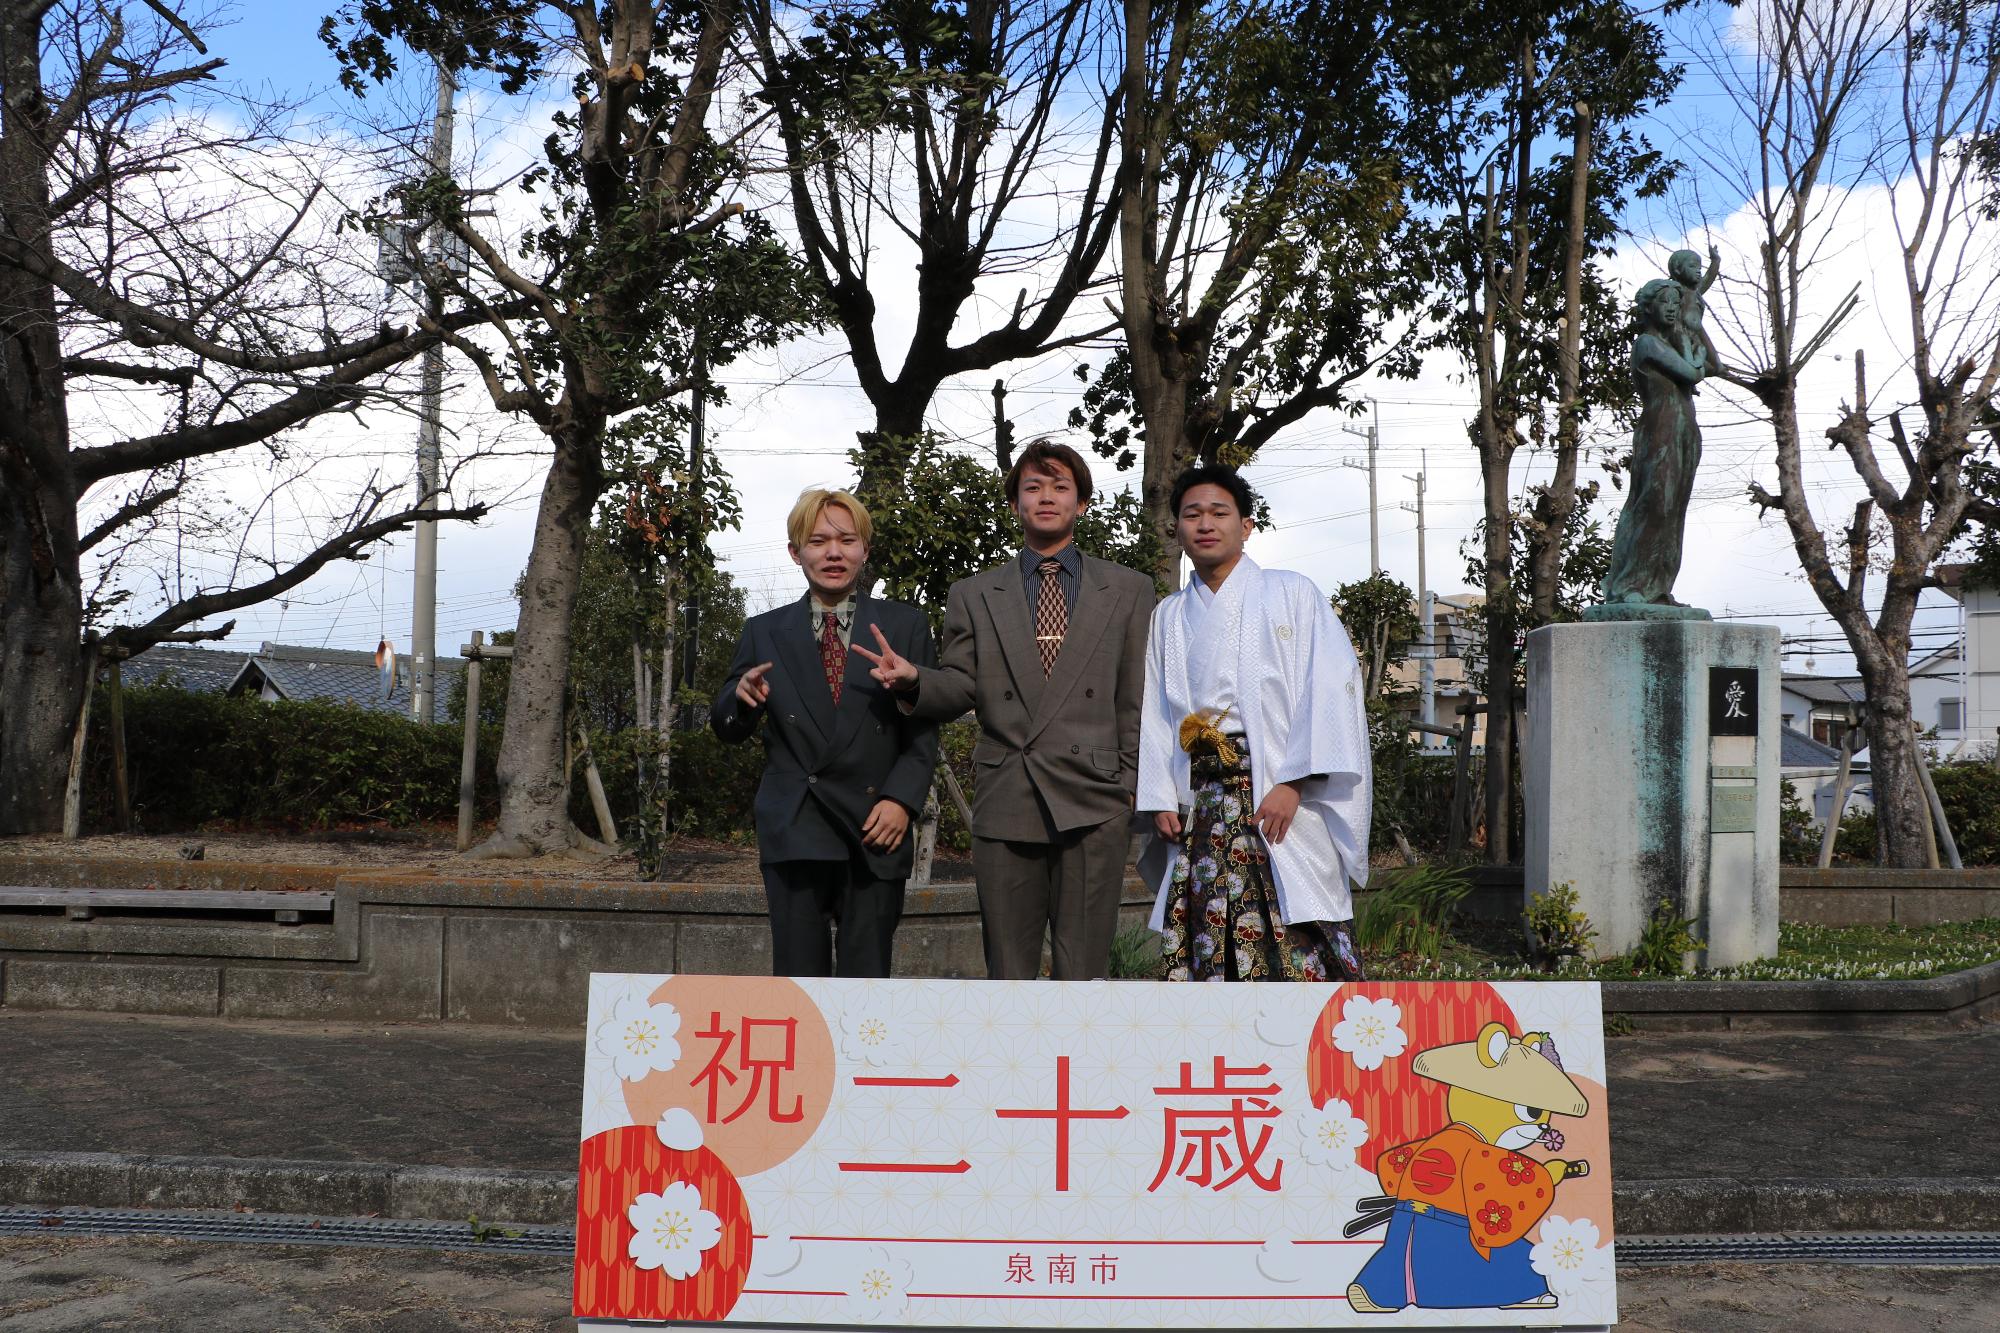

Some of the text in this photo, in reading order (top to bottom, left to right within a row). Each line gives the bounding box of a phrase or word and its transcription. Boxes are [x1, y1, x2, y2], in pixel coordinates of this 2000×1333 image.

[1724, 679, 1749, 719] 愛
[689, 1011, 805, 1125] 祝
[838, 1055, 1284, 1193] 二十歳
[1004, 1252, 1120, 1285] 泉南市
